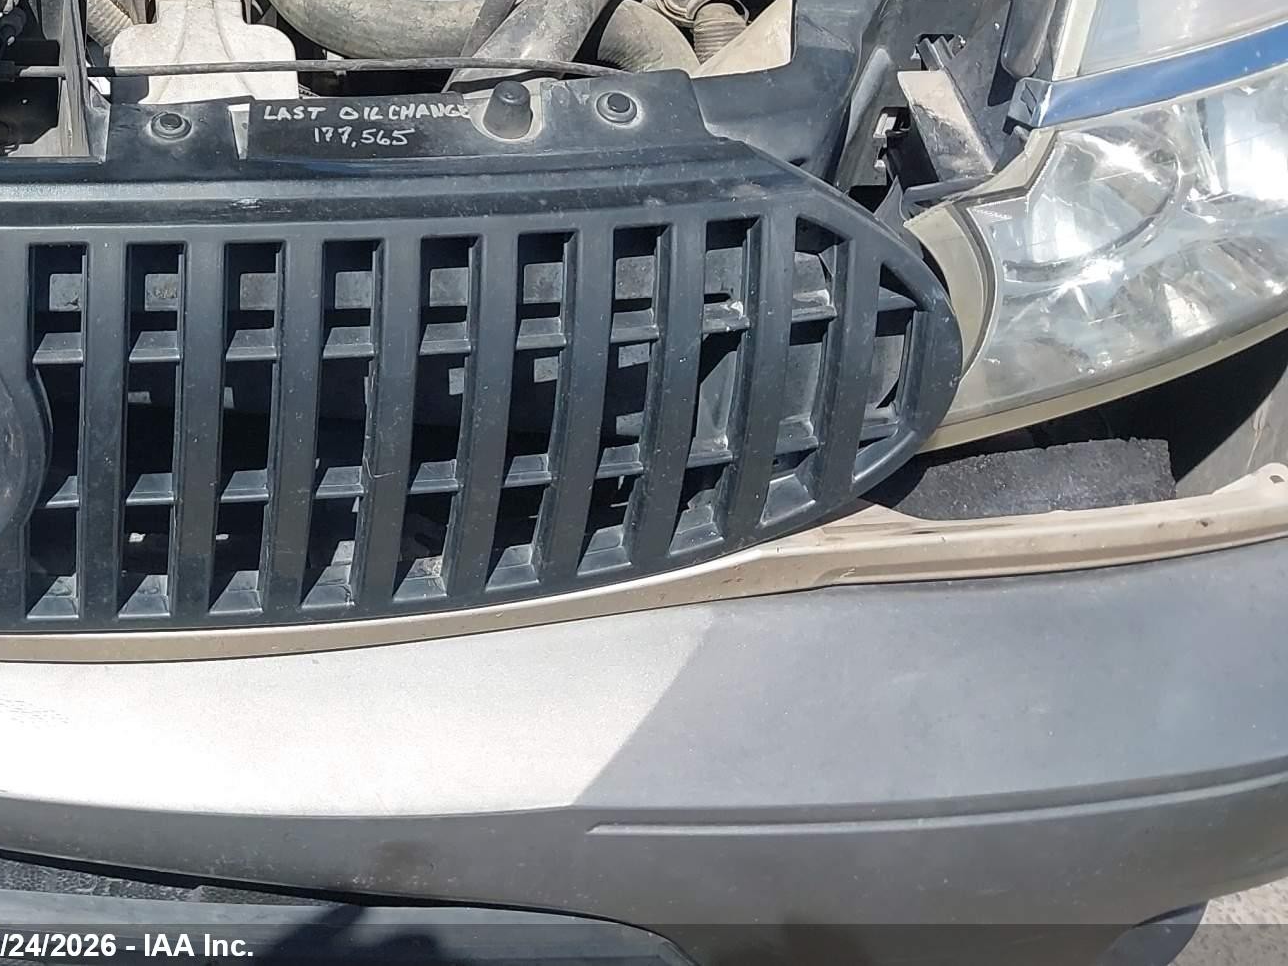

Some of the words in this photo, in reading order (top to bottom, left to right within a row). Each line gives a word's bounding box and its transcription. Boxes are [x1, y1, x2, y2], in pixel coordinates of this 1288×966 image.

[263, 105, 326, 121] LAST
[338, 106, 383, 121] OIL
[388, 102, 471, 121] CHANGE
[314, 126, 415, 148] 177,565
